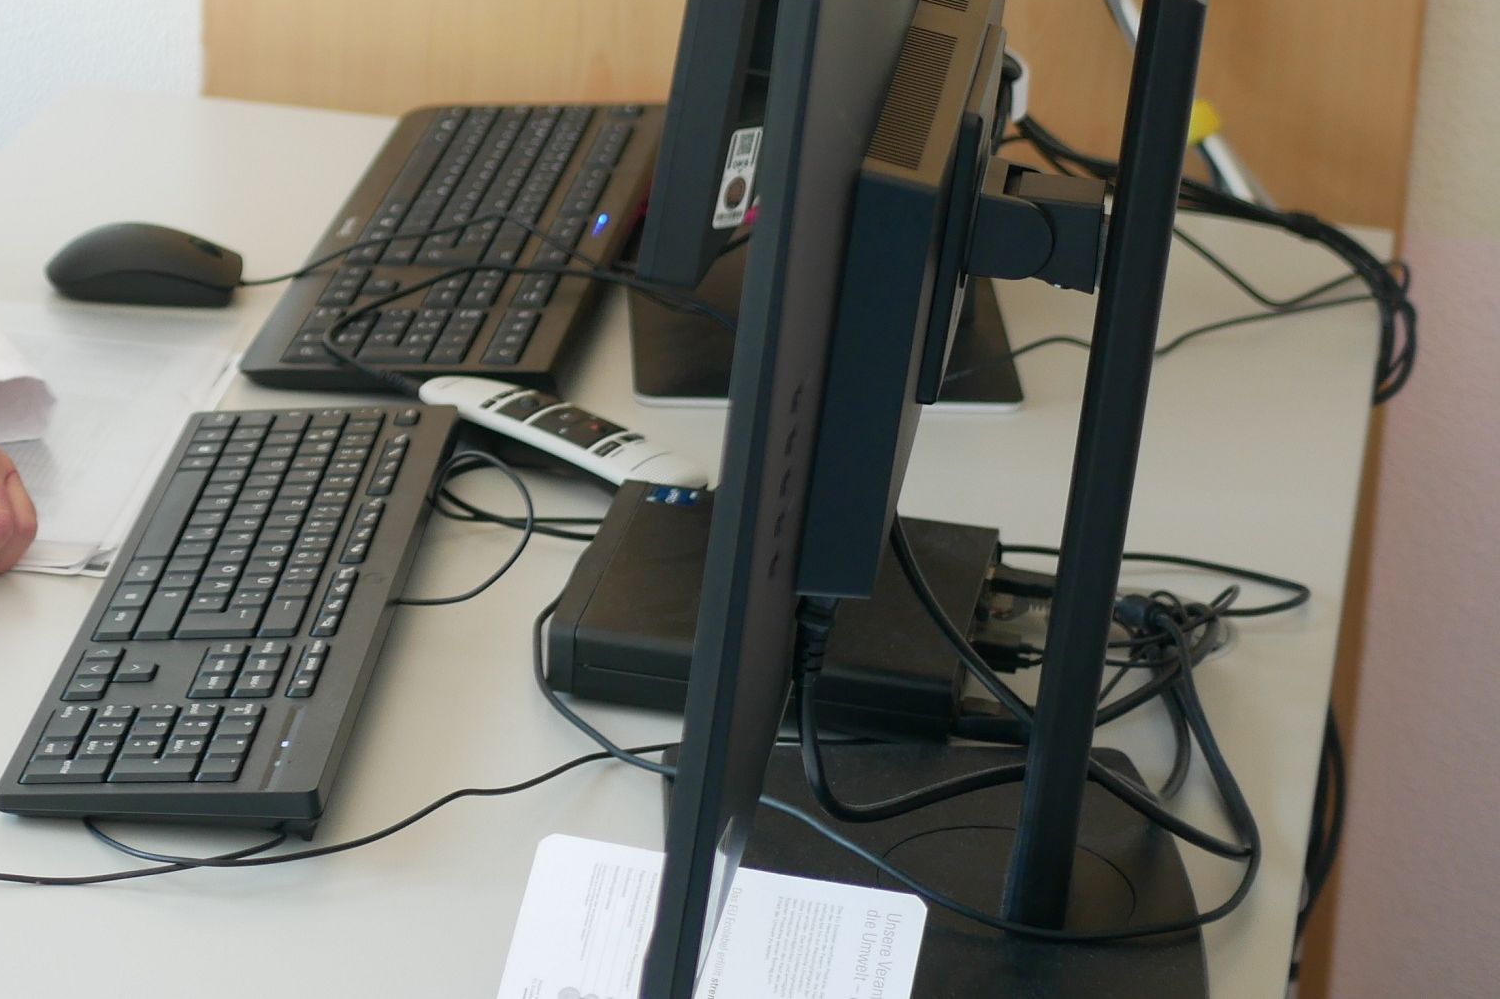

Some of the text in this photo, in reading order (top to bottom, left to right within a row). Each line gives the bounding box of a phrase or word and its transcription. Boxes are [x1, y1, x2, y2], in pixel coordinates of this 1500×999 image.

[864, 909, 881, 929] die
[879, 913, 902, 957] Unsere
[853, 932, 874, 982] Umwelt
